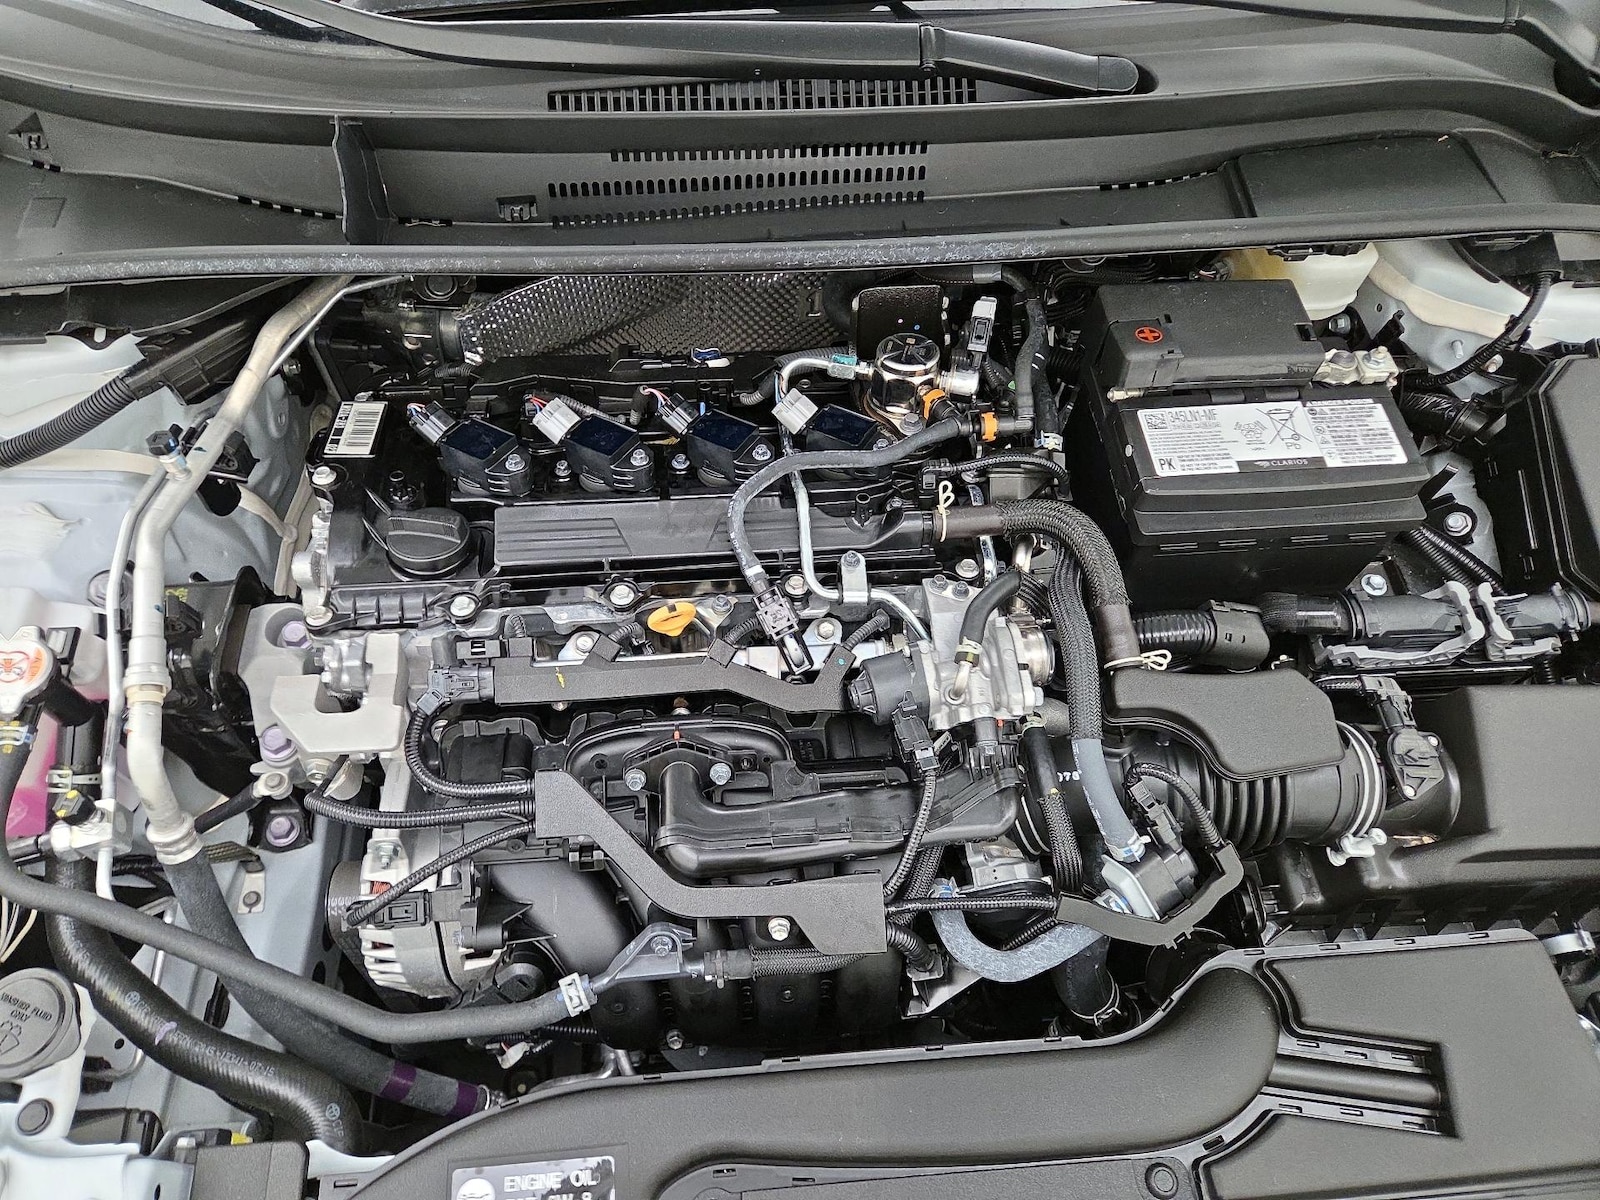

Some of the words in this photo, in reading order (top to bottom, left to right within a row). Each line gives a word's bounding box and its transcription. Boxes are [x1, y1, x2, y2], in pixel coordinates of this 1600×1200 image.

[1168, 408, 1218, 423] 345LN1-MF
[1159, 457, 1176, 471] PK
[1271, 458, 1309, 467] CLARIOS
[10, 1009, 32, 1023] ONLY
[31, 1006, 53, 1022] FLUID
[503, 1171, 564, 1193] ENGINE
[569, 1169, 599, 1188] OIL
